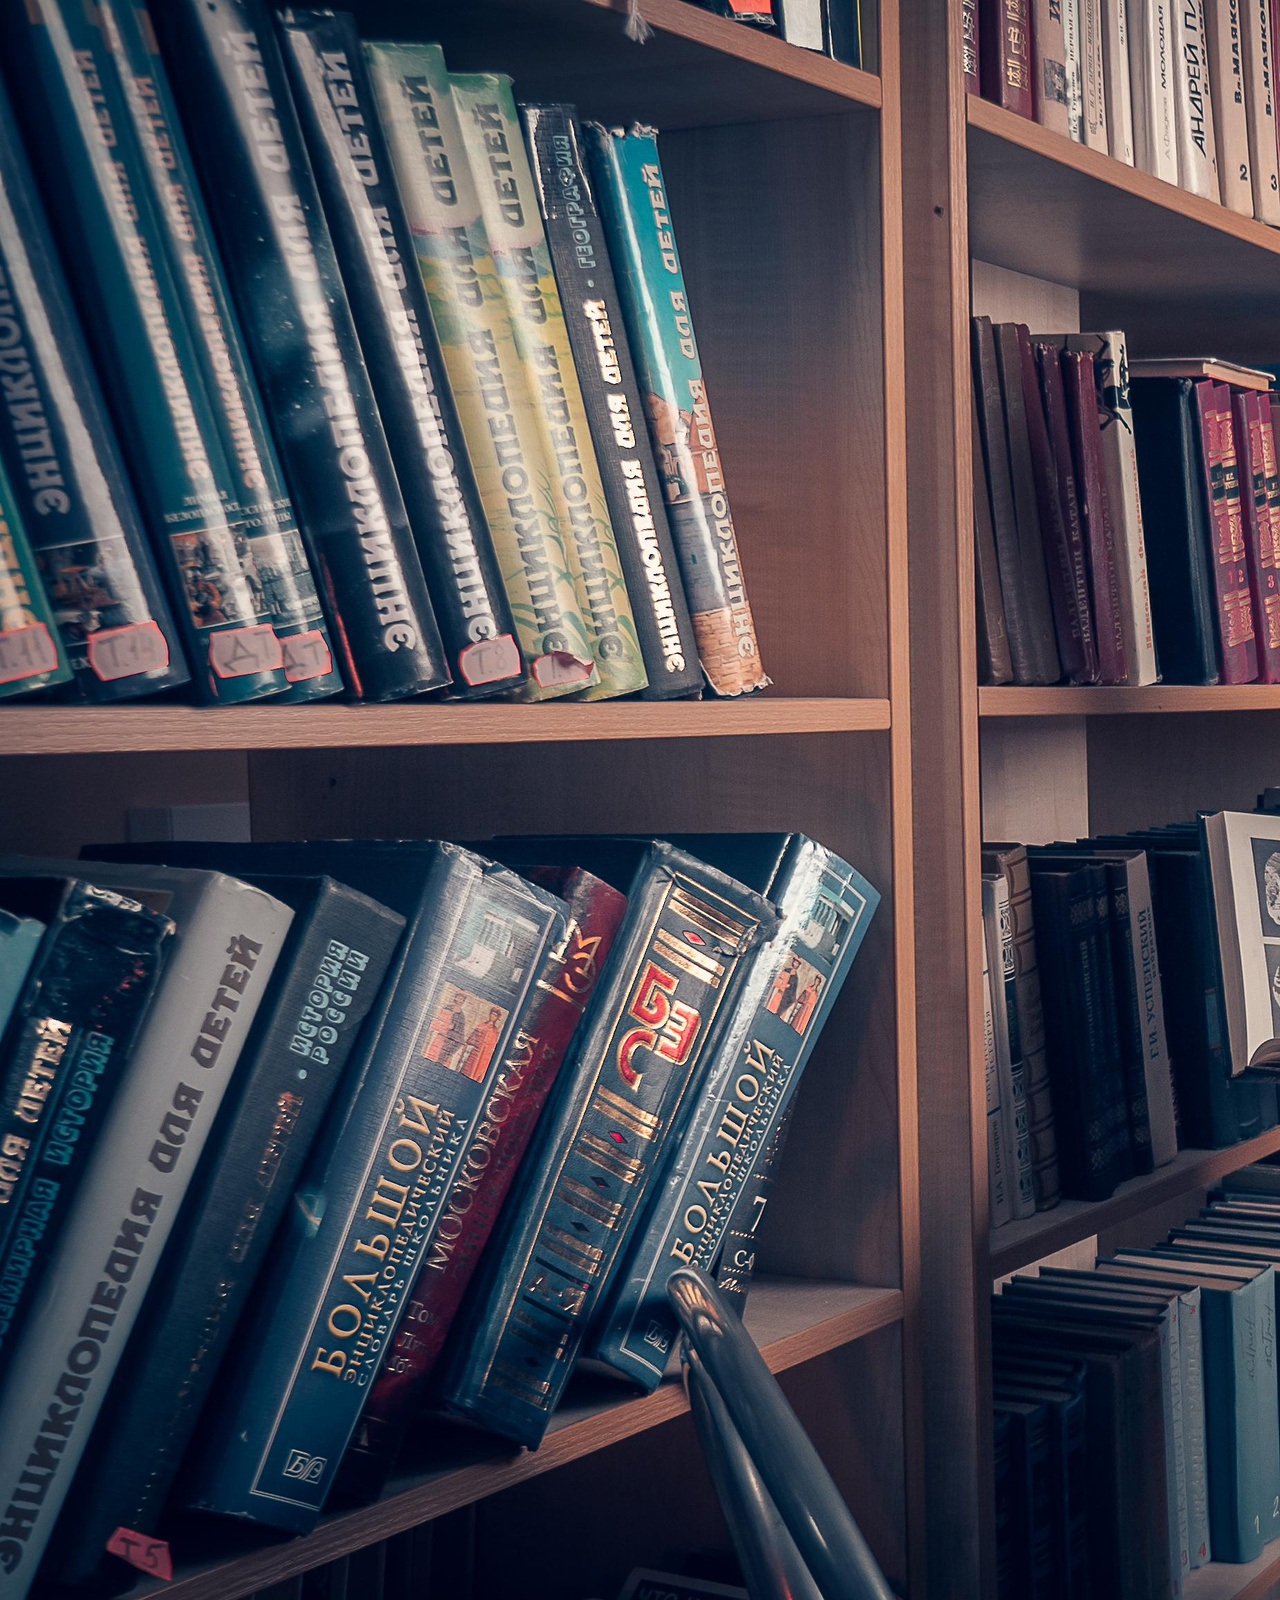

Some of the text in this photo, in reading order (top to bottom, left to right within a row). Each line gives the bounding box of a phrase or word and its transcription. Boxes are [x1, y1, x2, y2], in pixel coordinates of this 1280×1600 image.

[226, 31, 292, 175] ДЕТЕЙ
[1156, 5, 1169, 91] МОЛОДАЯ
[1183, 45, 1208, 158] АНДРЕЙ
[321, 51, 381, 188] ДЕТЕЙ
[400, 75, 459, 207] ДЕТЕЙ
[471, 102, 527, 229] ДЕТЕЙ
[1239, 164, 1249, 182] 2
[1269, 174, 1279, 191] 3
[271, 194, 321, 283] ДЛЯ
[437, 225, 485, 309] ДЛЯ
[552, 134, 598, 270] ГЕОГРАФИЯ
[510, 246, 550, 326] ДЛЯ
[640, 163, 756, 659] ЭНЦИКЛОПЕДИЯ ДЛЯ ДЕТЕЙ
[466, 328, 571, 655] ЭНЦИКЛОПЕДИЯ
[531, 345, 625, 661] ЭНЦИКЛОПЕДИЯ
[582, 299, 686, 675] ЭНЦИКЛОПЕДИЯ ДЛЯ ДЕТЕЙ
[1066, 475, 1091, 643] ВАЛЕНТИН КАТАЕВ
[1108, 560, 1124, 651] ВАЛЕНТИН
[290, 939, 350, 1057] ИСТОРИЯ
[310, 949, 370, 1065] РОССИИ
[1137, 910, 1155, 1025] УСПЕНСКИЙ
[14, 1016, 72, 1124] ДЕТЕЙ
[46, 1031, 115, 1166] ИСТОРИЯ
[425, 1027, 540, 1275] МОСКОВСКАЯ
[670, 1038, 776, 1265] БОЛЬШОЙ
[702, 1190, 737, 1268] ЛОВАРЬ
[737, 1063, 792, 1183] ШКОЛЬНИКА
[0, 934, 263, 1575] ЭНЦИКЛОПЕДИЯ ДЛЯ ДЕТЕЙ
[311, 1094, 442, 1380] БОЛЬШОЙ
[343, 1108, 456, 1385] ЭНЦИКЛОПЕДИЧЕСКИЙ
[357, 1279, 405, 1387] СЛОВАРЬ
[403, 1118, 469, 1268] ШКОЛЬНИКА
